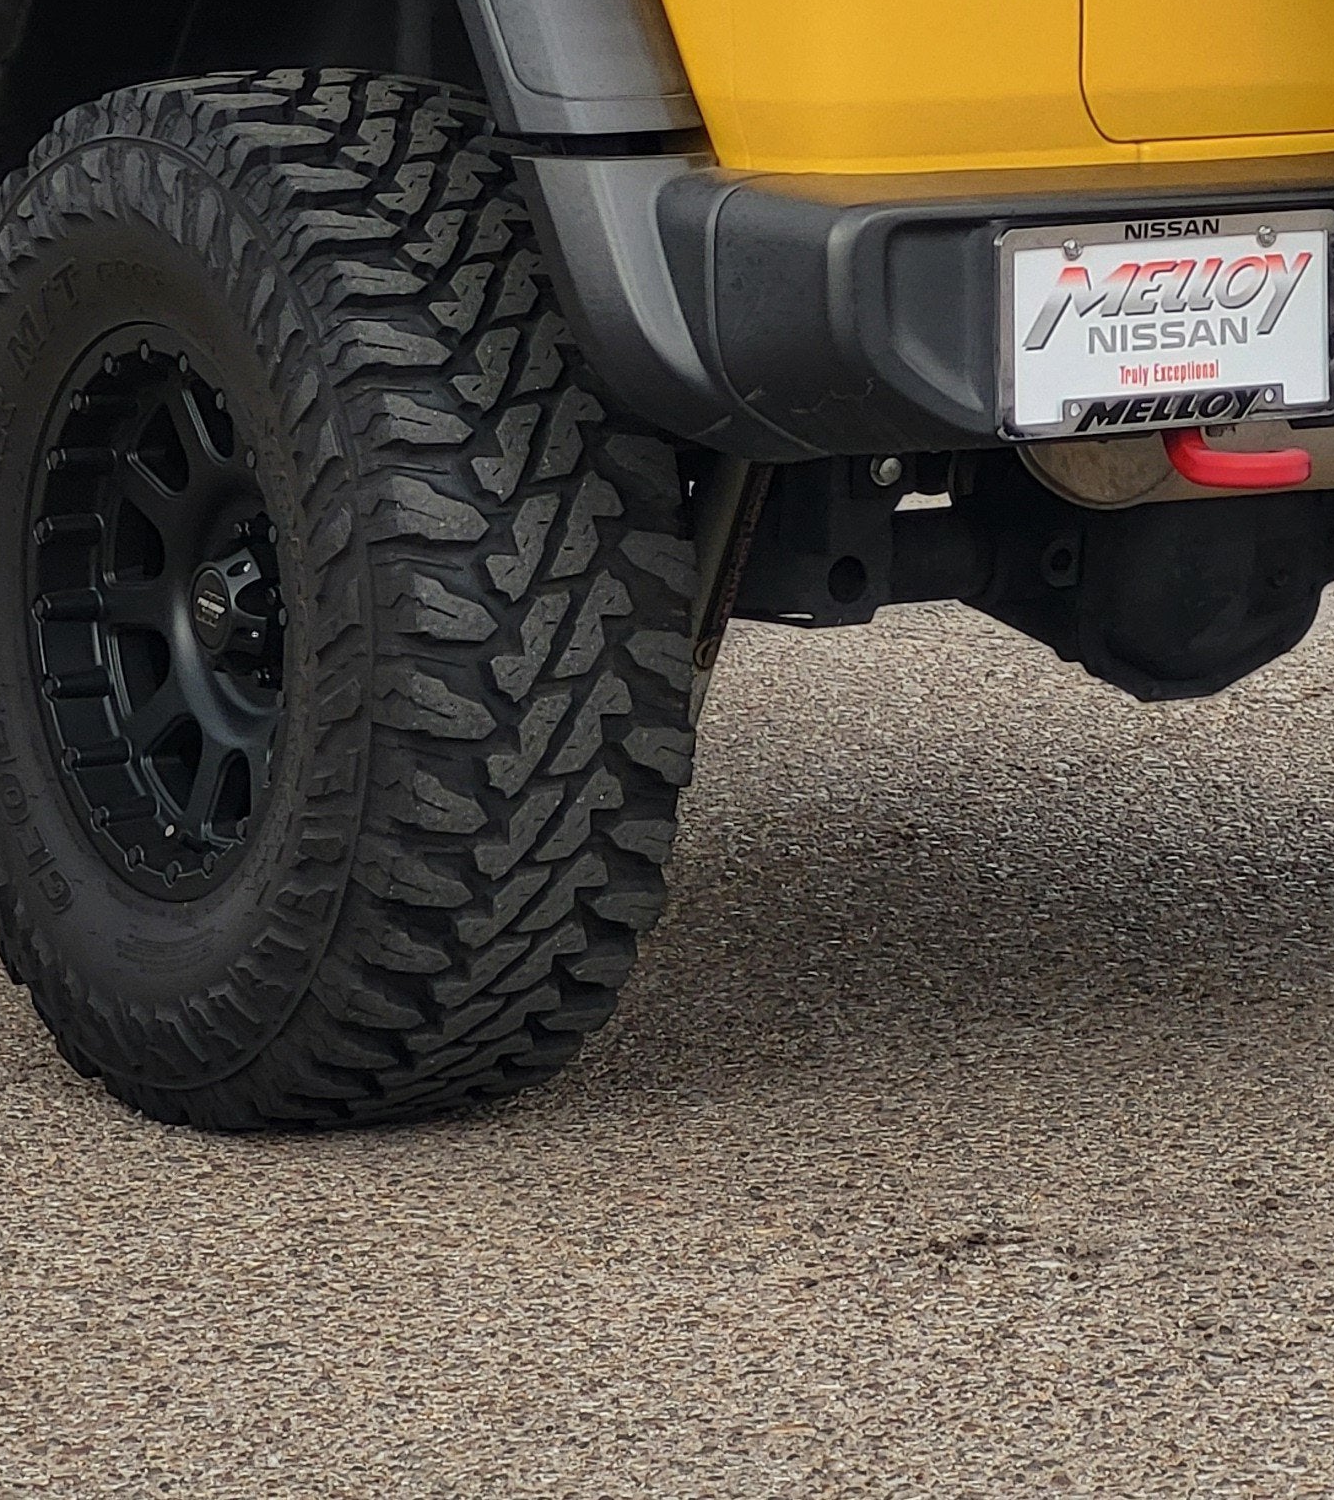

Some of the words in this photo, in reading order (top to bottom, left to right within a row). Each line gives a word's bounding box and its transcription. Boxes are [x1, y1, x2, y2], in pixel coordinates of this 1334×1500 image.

[1124, 218, 1220, 241] NISSAN
[1022, 252, 1312, 351] MELLOY
[1088, 316, 1248, 354] NISSAN
[1120, 364, 1149, 387] Truly
[1153, 359, 1219, 384] Exceptional
[1074, 388, 1261, 432] MELLOY
